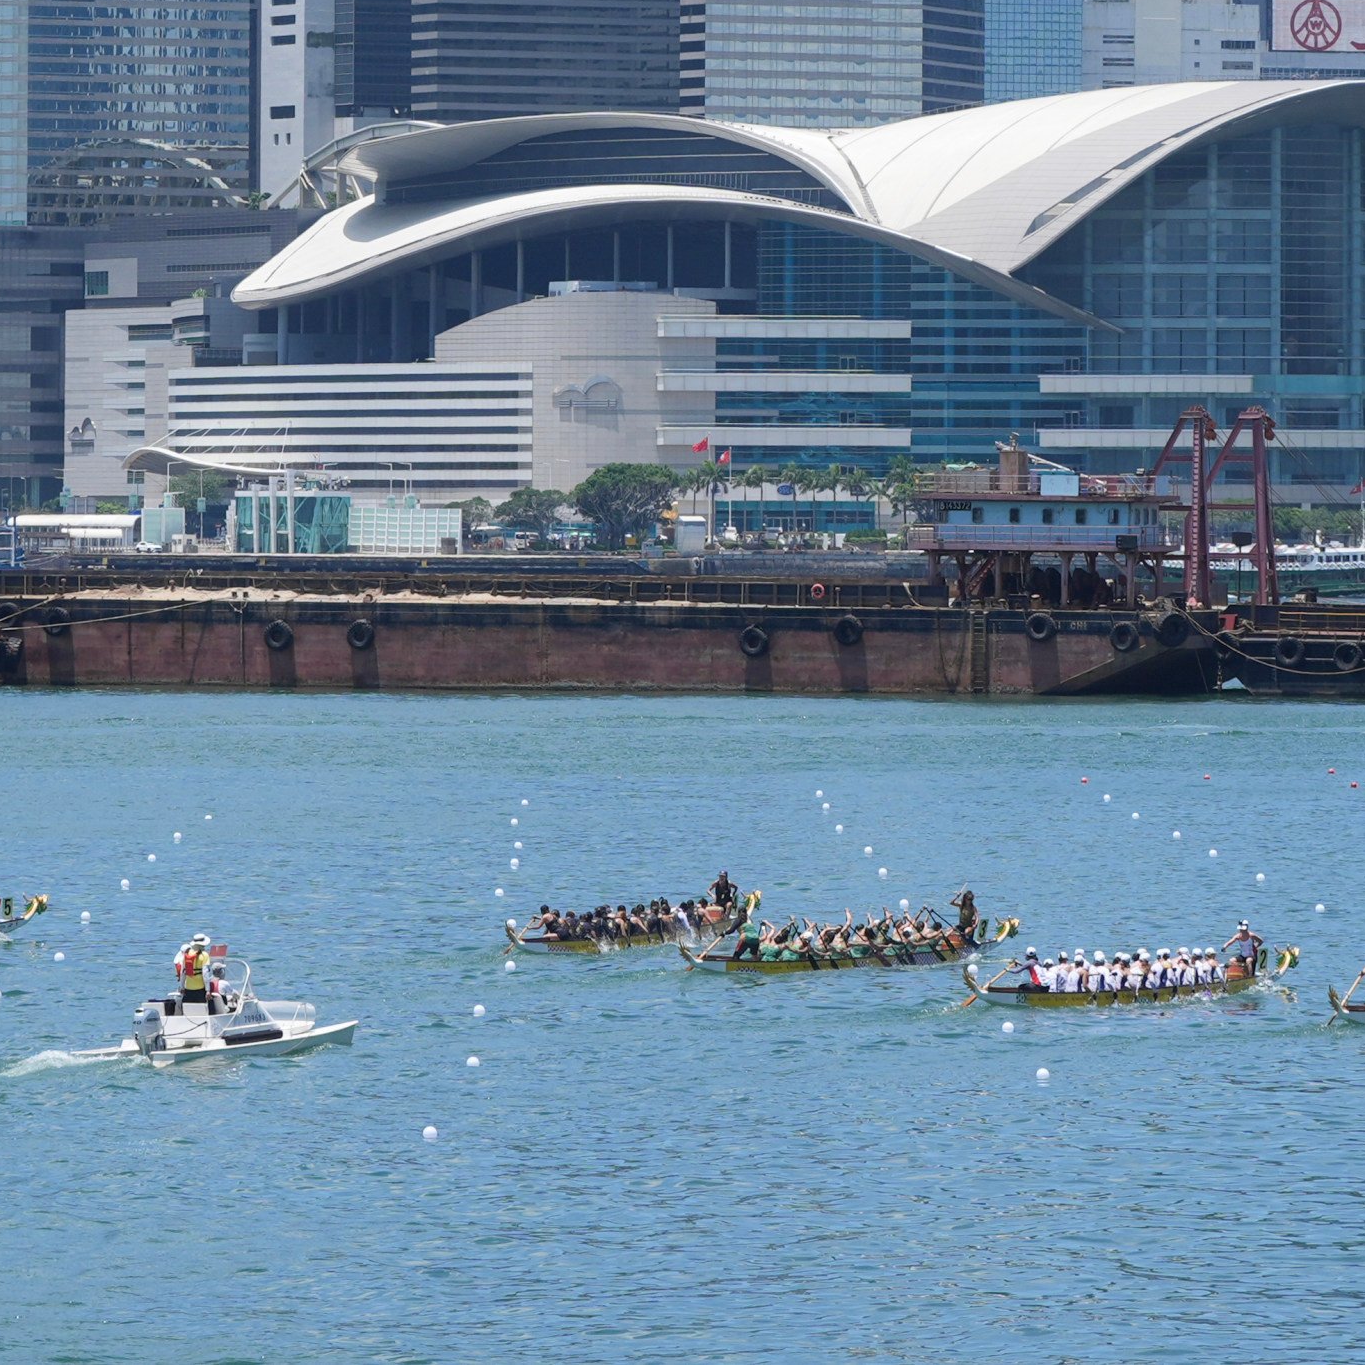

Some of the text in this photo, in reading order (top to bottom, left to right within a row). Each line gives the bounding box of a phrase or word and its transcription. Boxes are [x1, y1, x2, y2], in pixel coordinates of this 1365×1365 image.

[3, 898, 12, 916] 5
[979, 920, 987, 938] 3
[1259, 949, 1267, 970] 2
